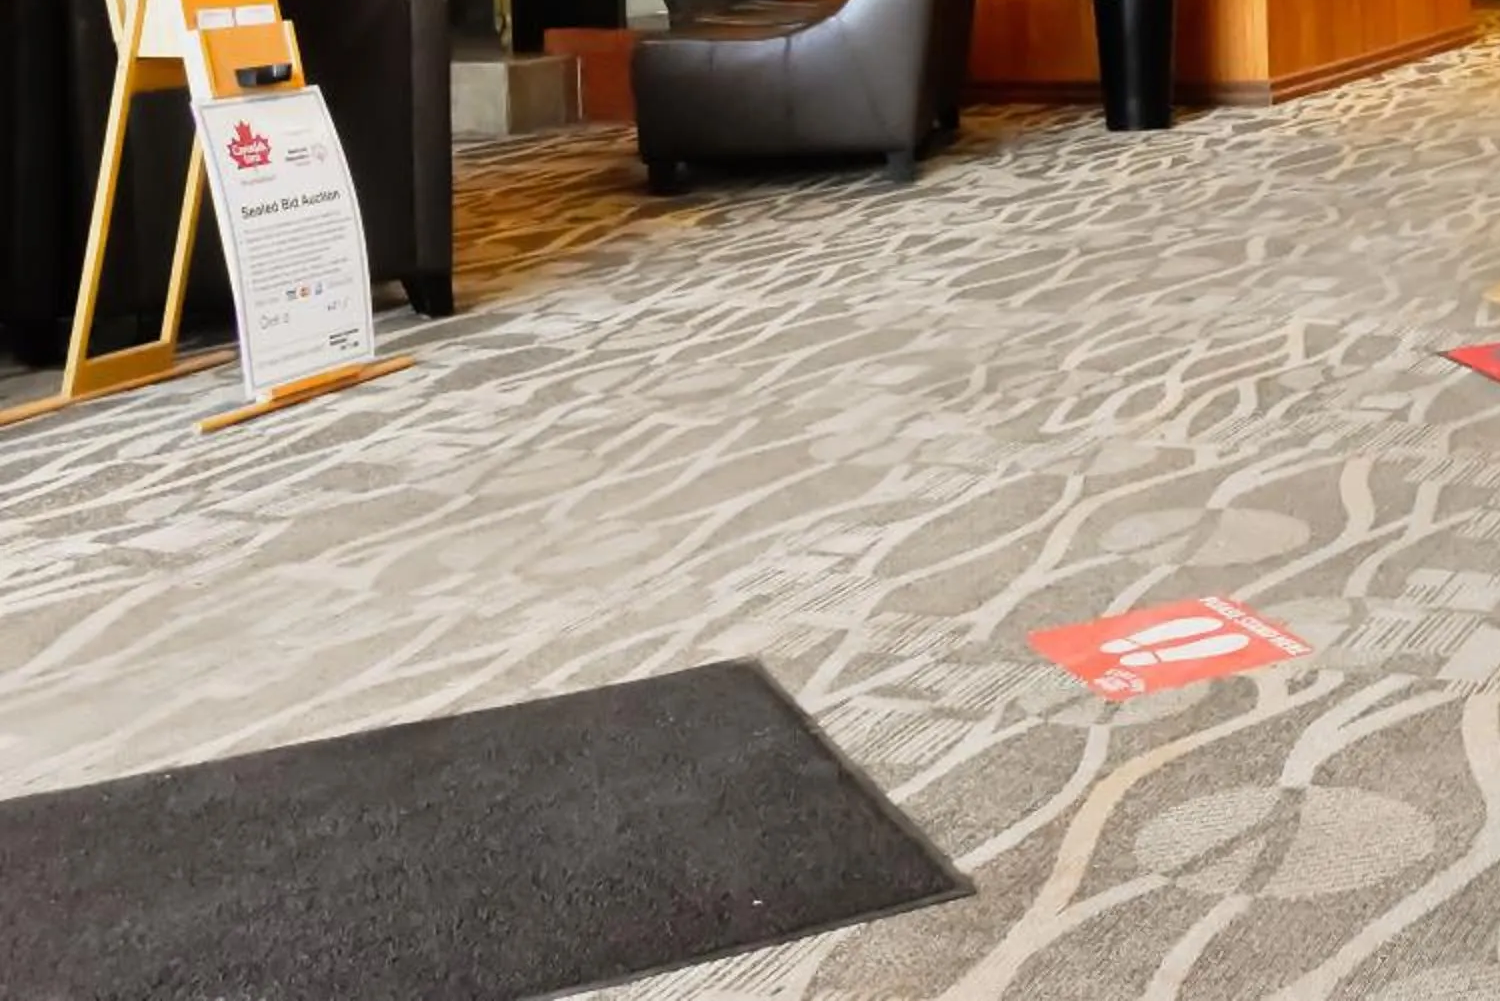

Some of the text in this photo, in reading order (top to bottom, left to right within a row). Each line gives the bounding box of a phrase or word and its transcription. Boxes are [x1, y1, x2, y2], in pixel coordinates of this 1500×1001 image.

[241, 190, 340, 219] Sealed Bid Auction
